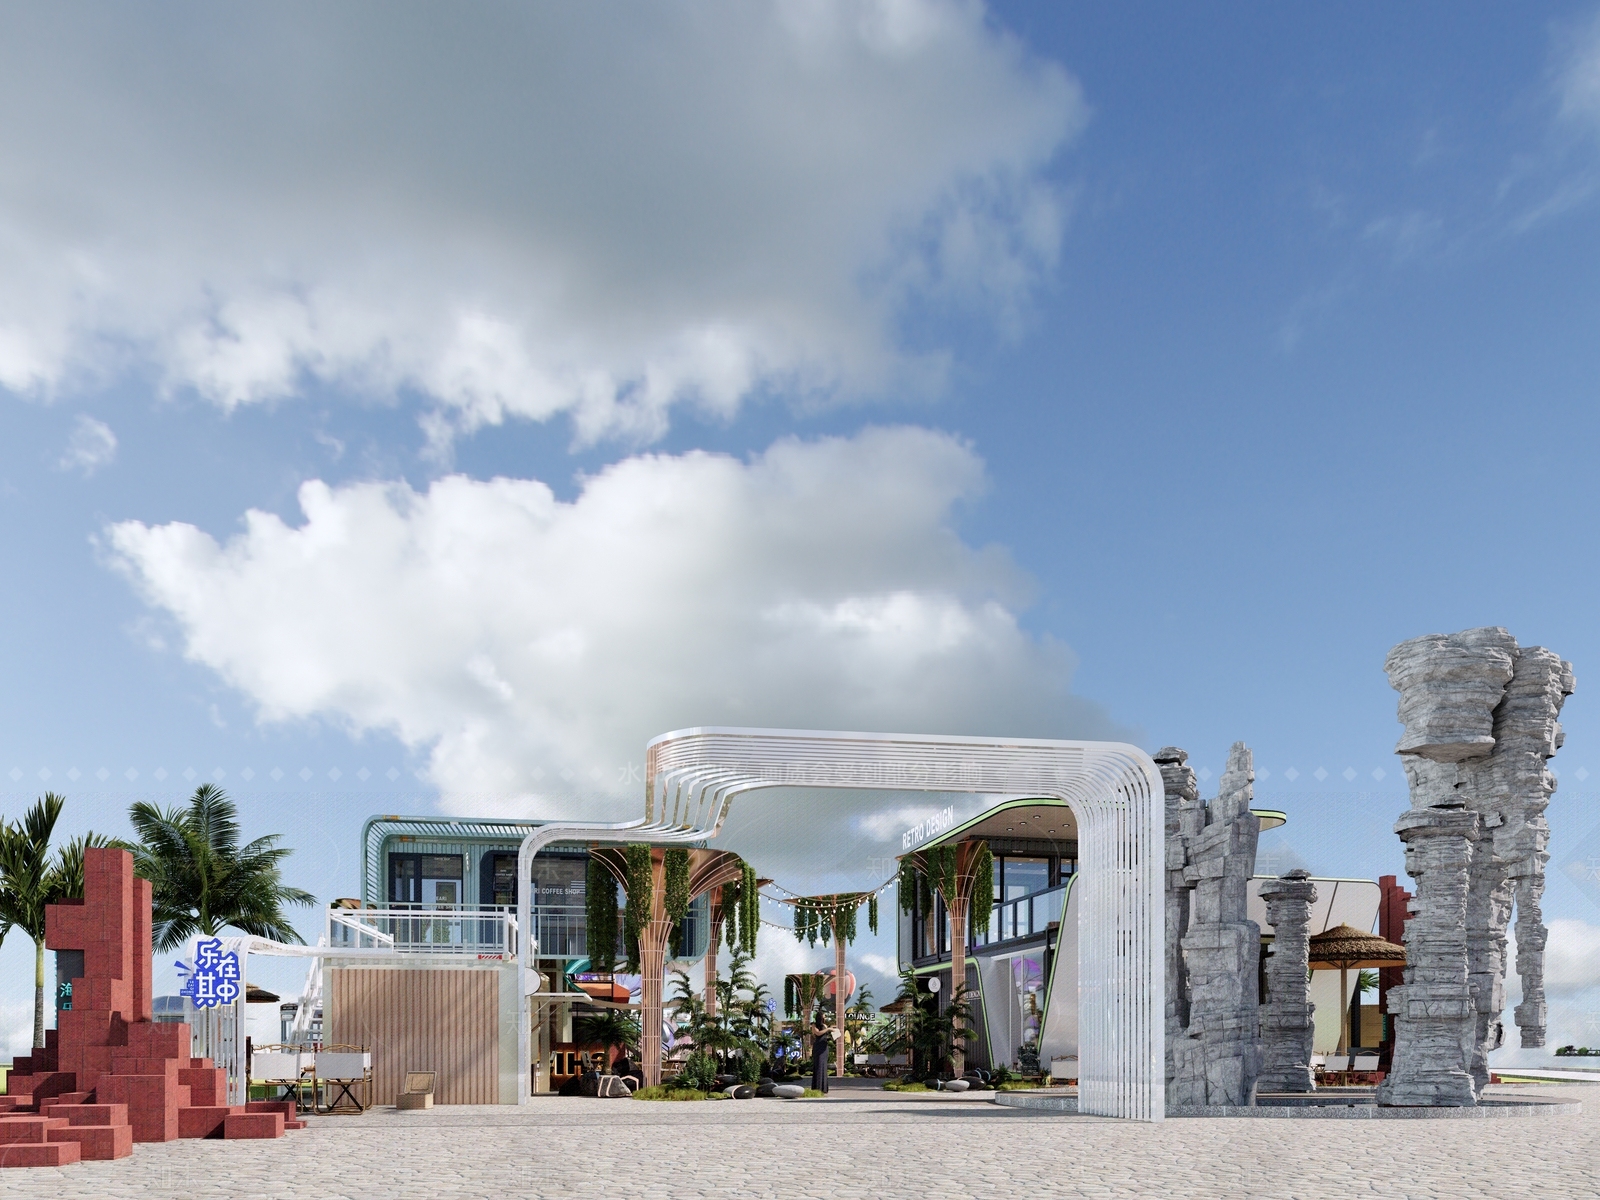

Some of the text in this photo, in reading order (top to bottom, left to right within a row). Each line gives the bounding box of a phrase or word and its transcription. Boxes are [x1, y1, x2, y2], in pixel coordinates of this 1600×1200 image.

[902, 804, 954, 851] RETRO DESIGN
[541, 887, 564, 895] COFFEE
[564, 887, 581, 896] SHOP
